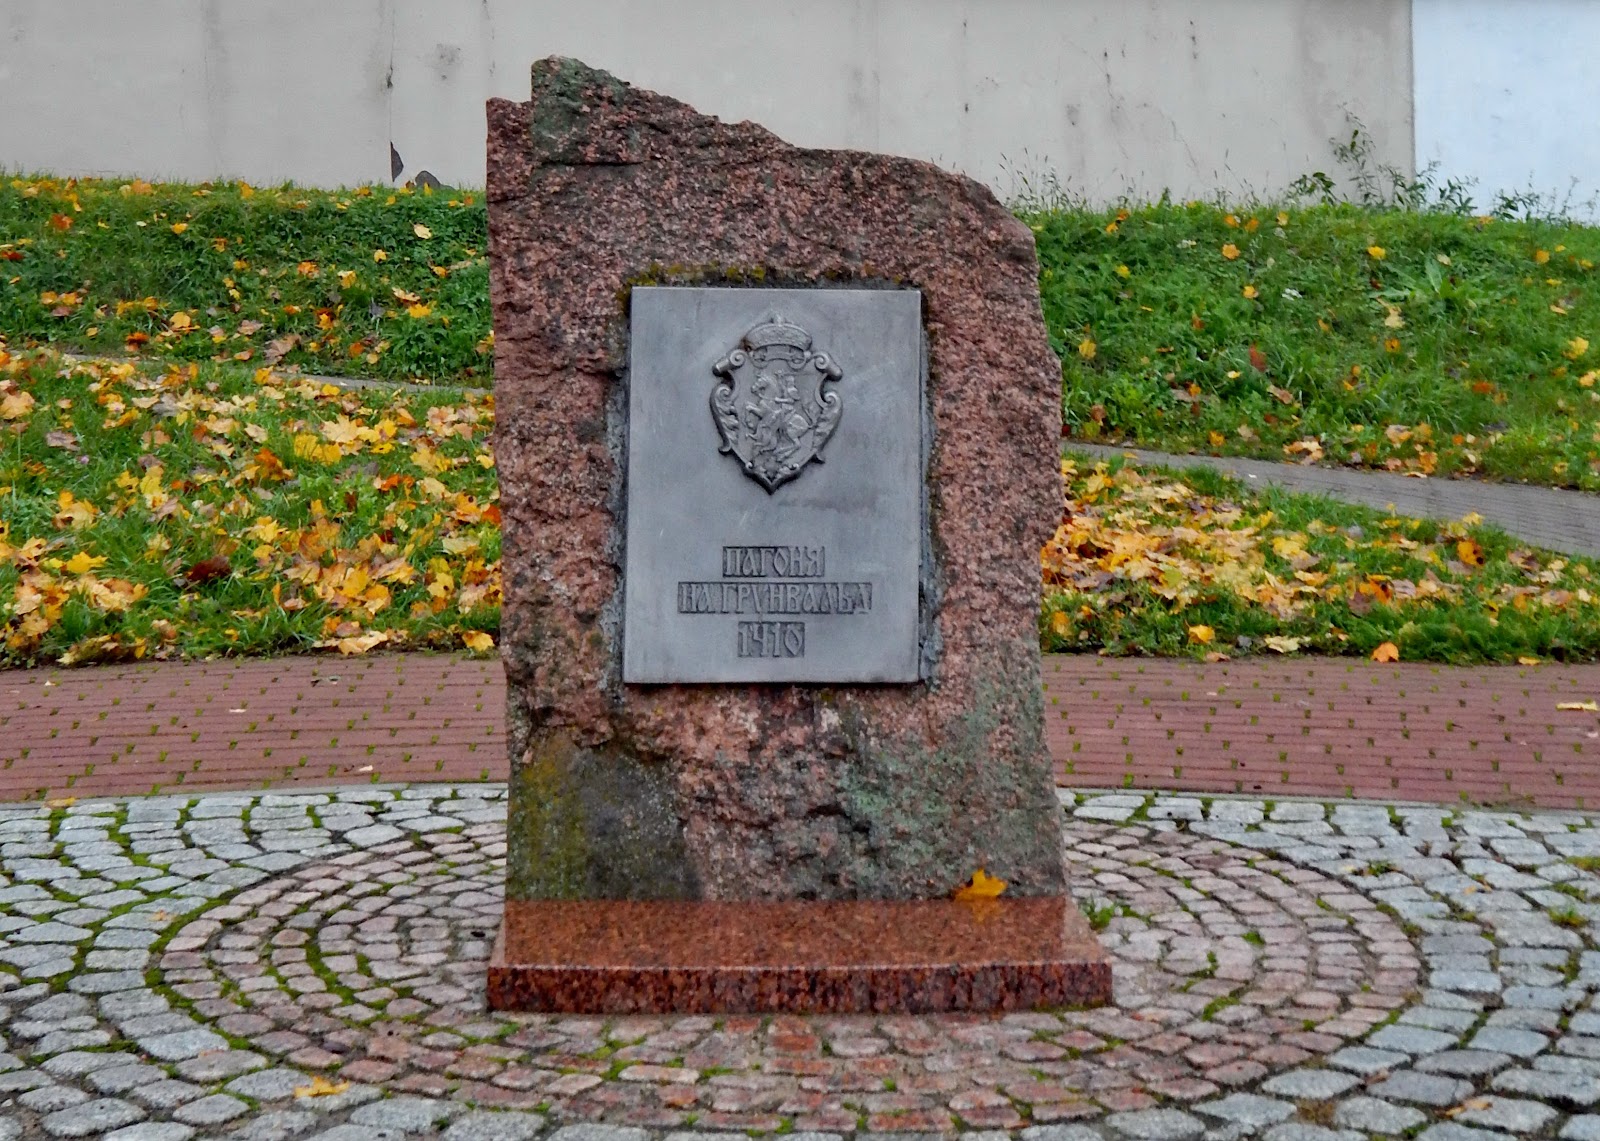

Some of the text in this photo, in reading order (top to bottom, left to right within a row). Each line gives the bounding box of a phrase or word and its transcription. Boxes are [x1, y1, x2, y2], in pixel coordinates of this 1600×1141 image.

[724, 547, 824, 577] ПАГОНЯ
[680, 583, 715, 613] НА
[739, 623, 804, 657] 1410
